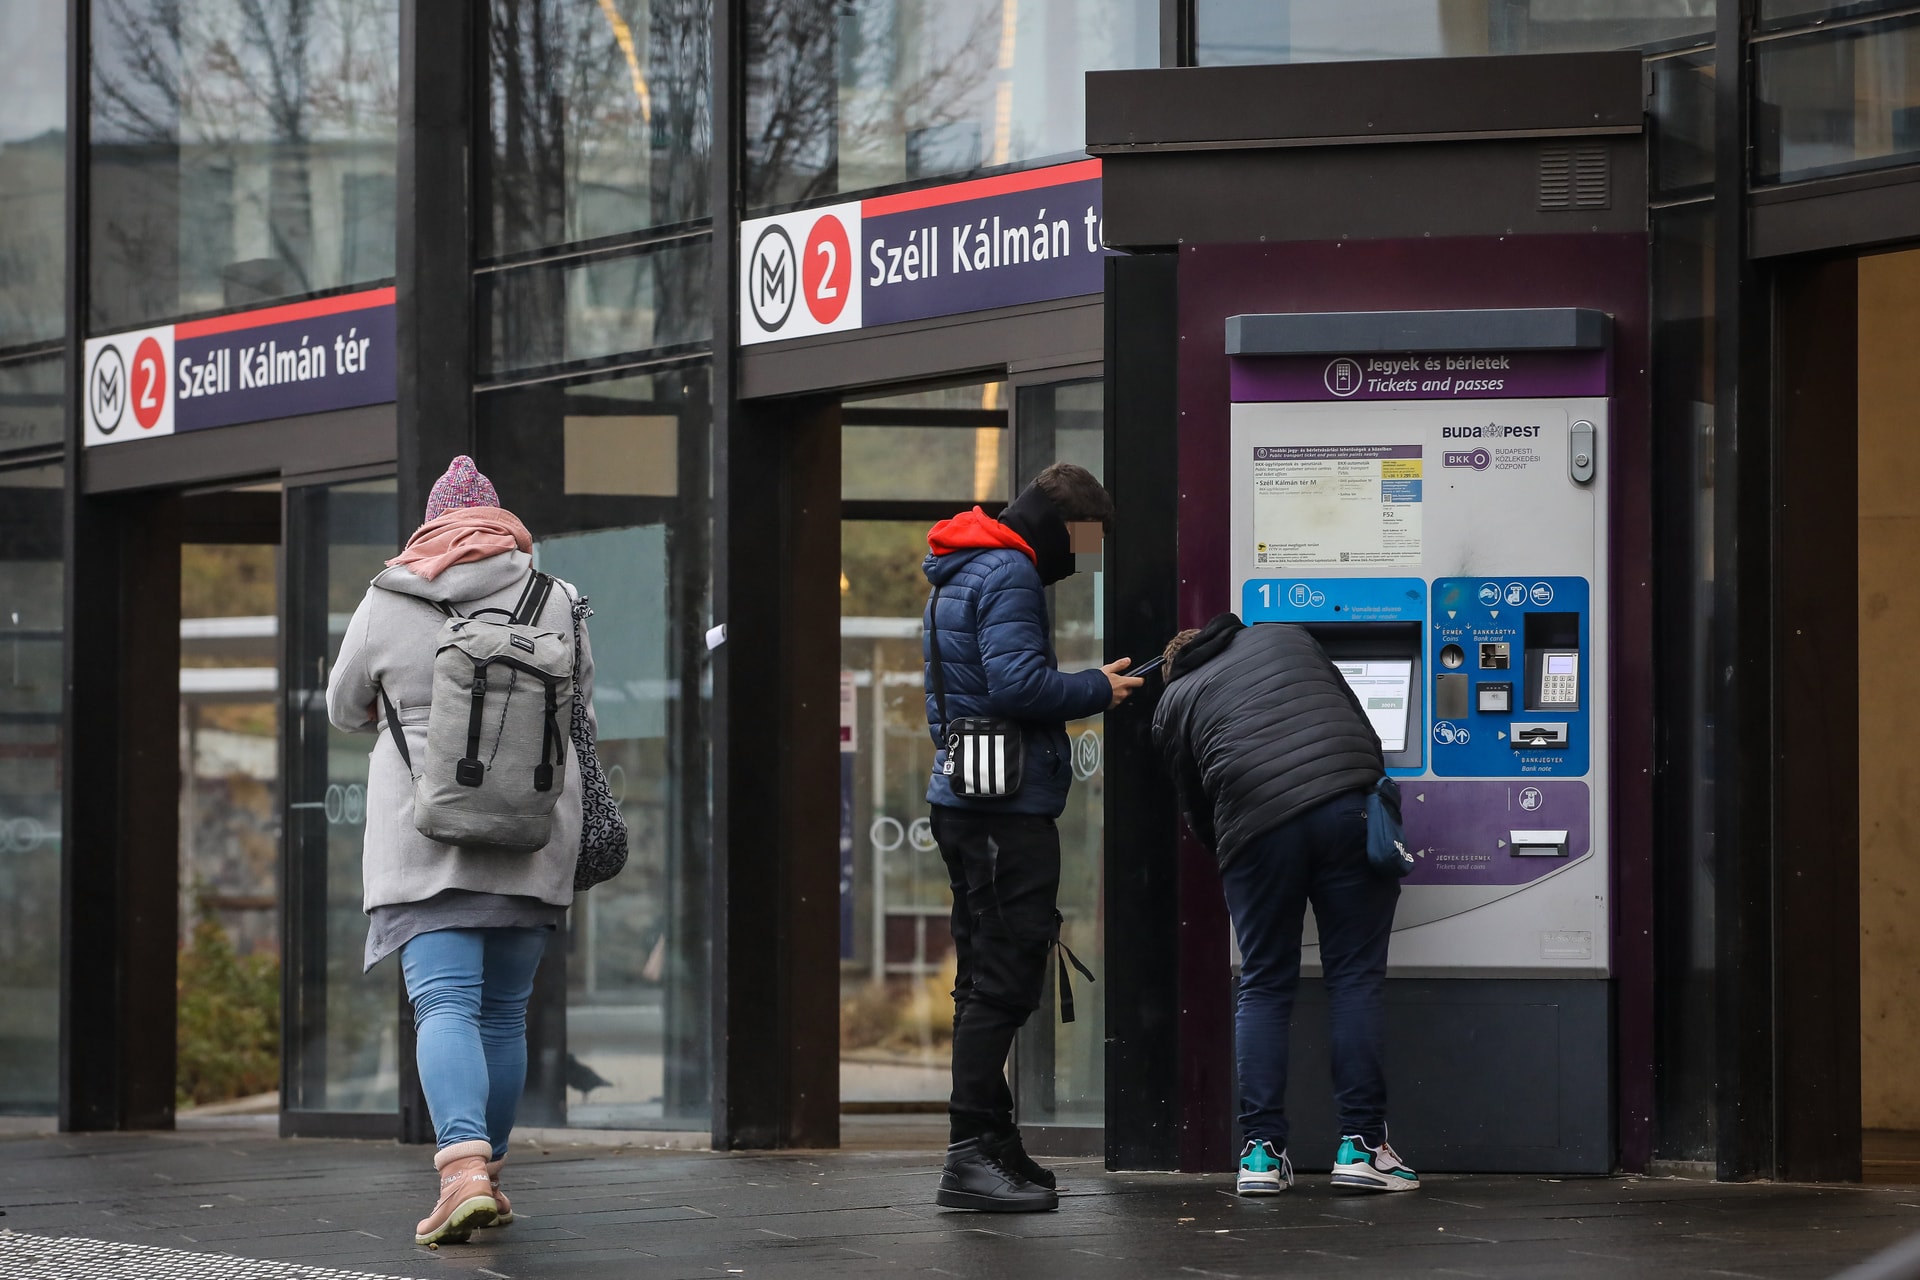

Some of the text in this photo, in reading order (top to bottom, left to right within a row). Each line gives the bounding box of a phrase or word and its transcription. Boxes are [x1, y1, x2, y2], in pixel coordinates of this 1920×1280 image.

[817, 240, 838, 300] 2
[870, 226, 939, 287] Széll
[952, 208, 1071, 274] Kálmán
[140, 358, 157, 409] 2
[178, 348, 231, 400] Széll
[239, 335, 326, 390] Kálmán
[334, 327, 371, 376] tér
[1367, 355, 1511, 375] Jegyek és bérletek
[1367, 377, 1504, 395] Tickets and passes
[1449, 455, 1470, 464] BKK
[1495, 455, 1541, 463] KÖZLEKEDÉSI
[1258, 583, 1270, 608] 1
